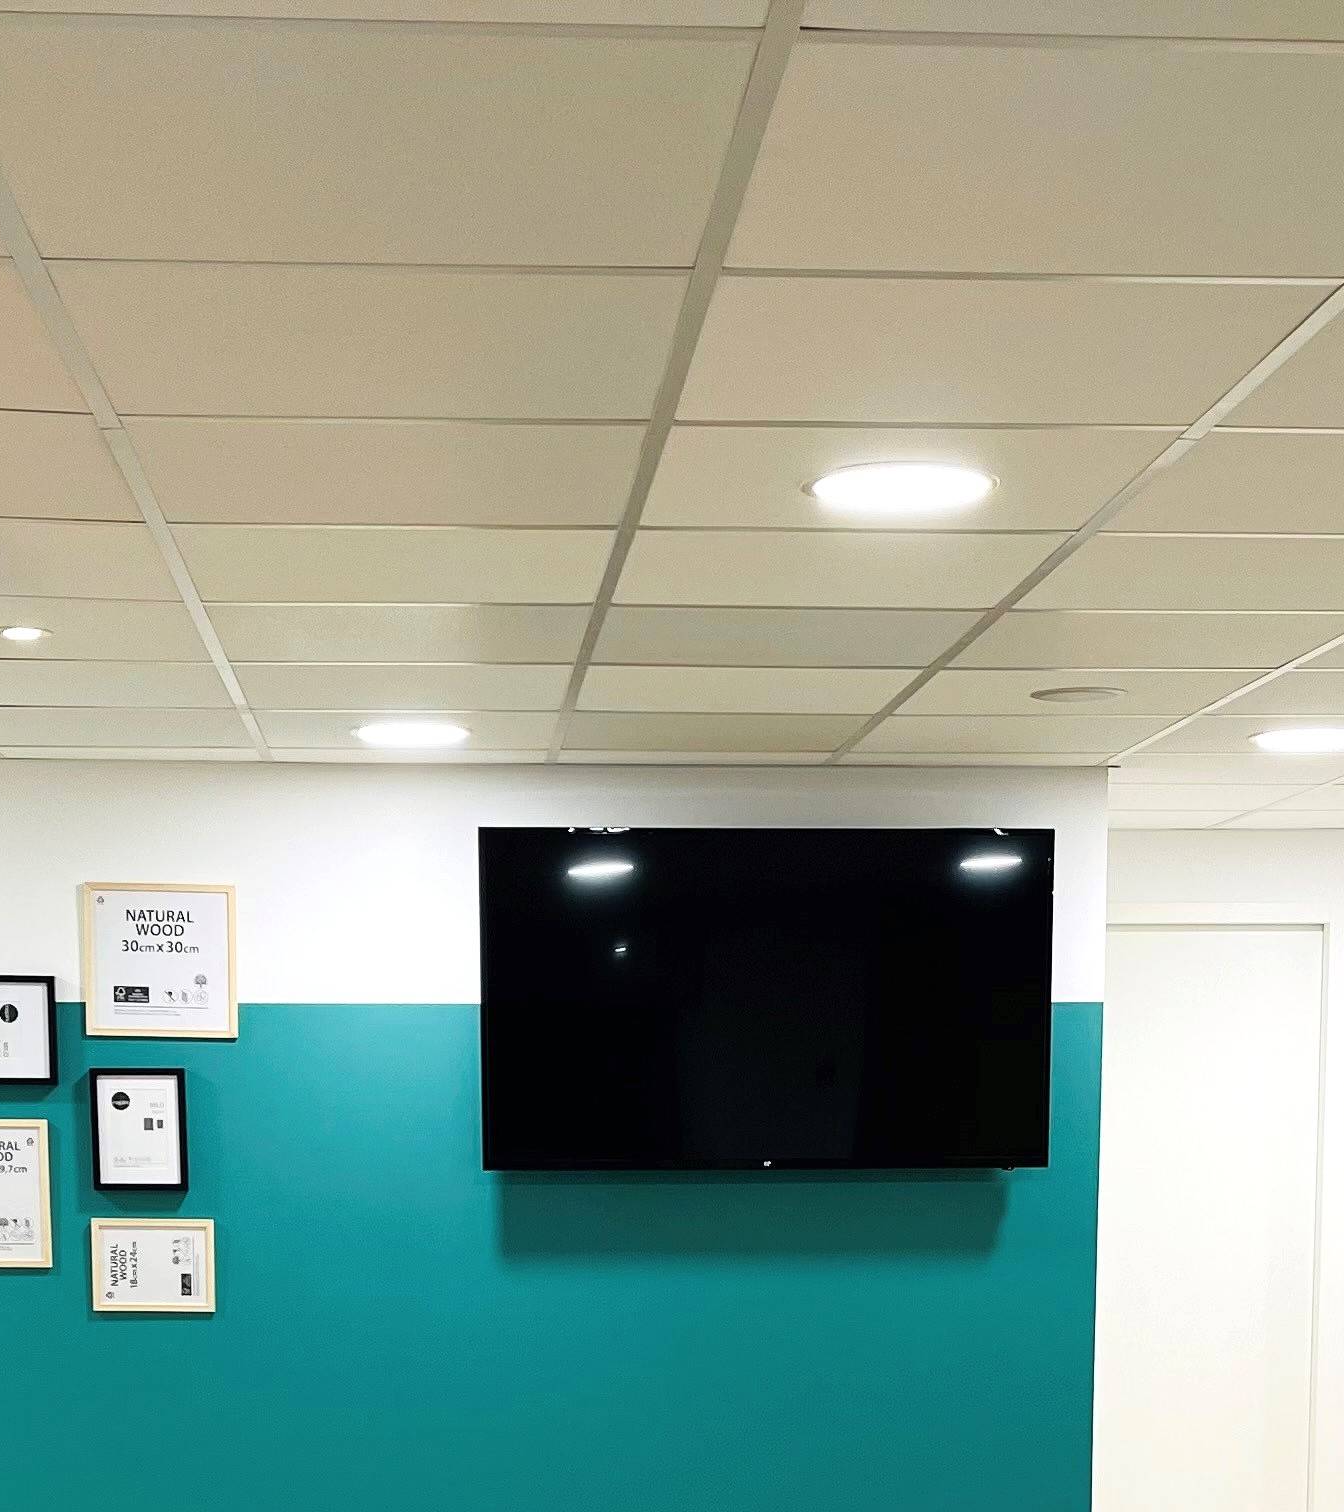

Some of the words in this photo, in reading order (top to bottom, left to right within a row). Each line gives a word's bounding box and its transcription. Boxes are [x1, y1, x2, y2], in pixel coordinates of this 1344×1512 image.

[125, 909, 194, 923] NATURAL
[135, 923, 184, 936] WOOD
[110, 1243, 119, 1287] NATURAL
[118, 1249, 127, 1280] WOOD
